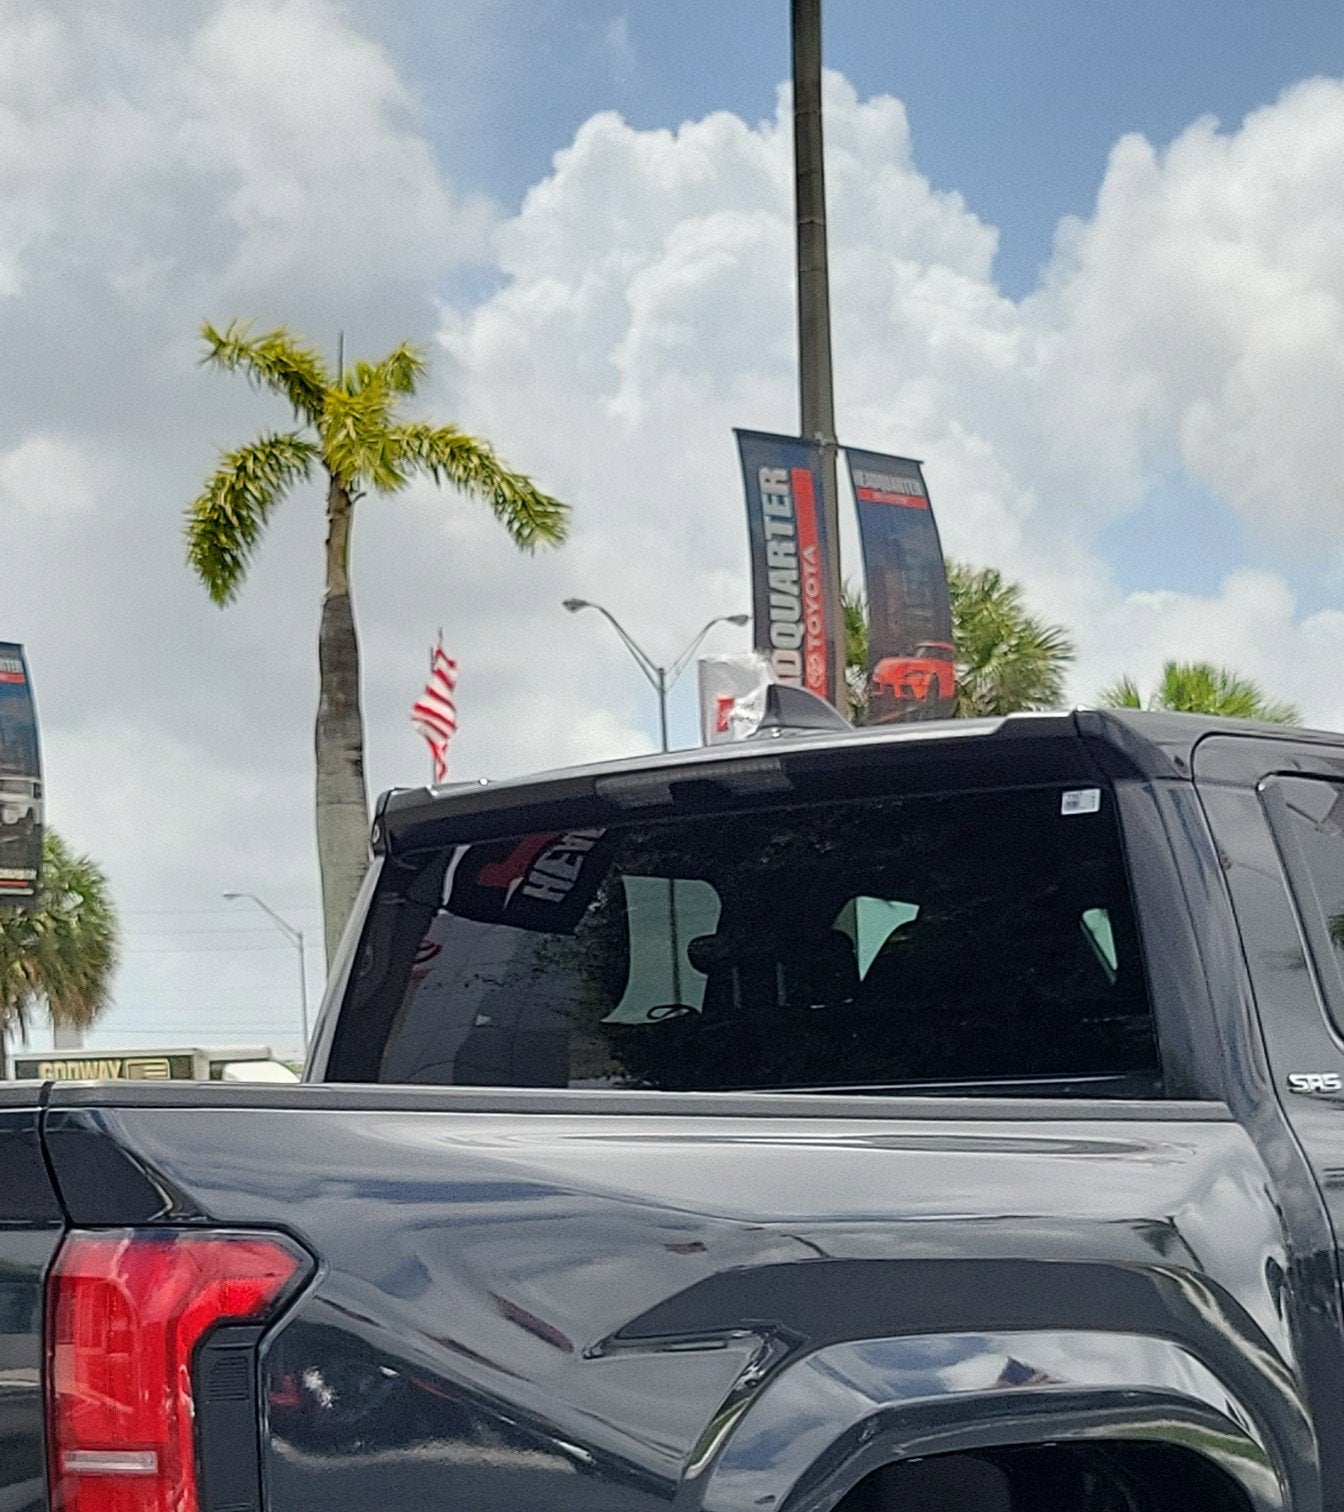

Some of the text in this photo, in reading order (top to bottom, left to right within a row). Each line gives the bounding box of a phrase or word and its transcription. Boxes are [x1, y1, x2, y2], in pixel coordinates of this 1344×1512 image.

[759, 466, 803, 685] DQUARTER
[802, 545, 822, 650] TOYOTA
[1287, 1072, 1343, 1094] SR5
